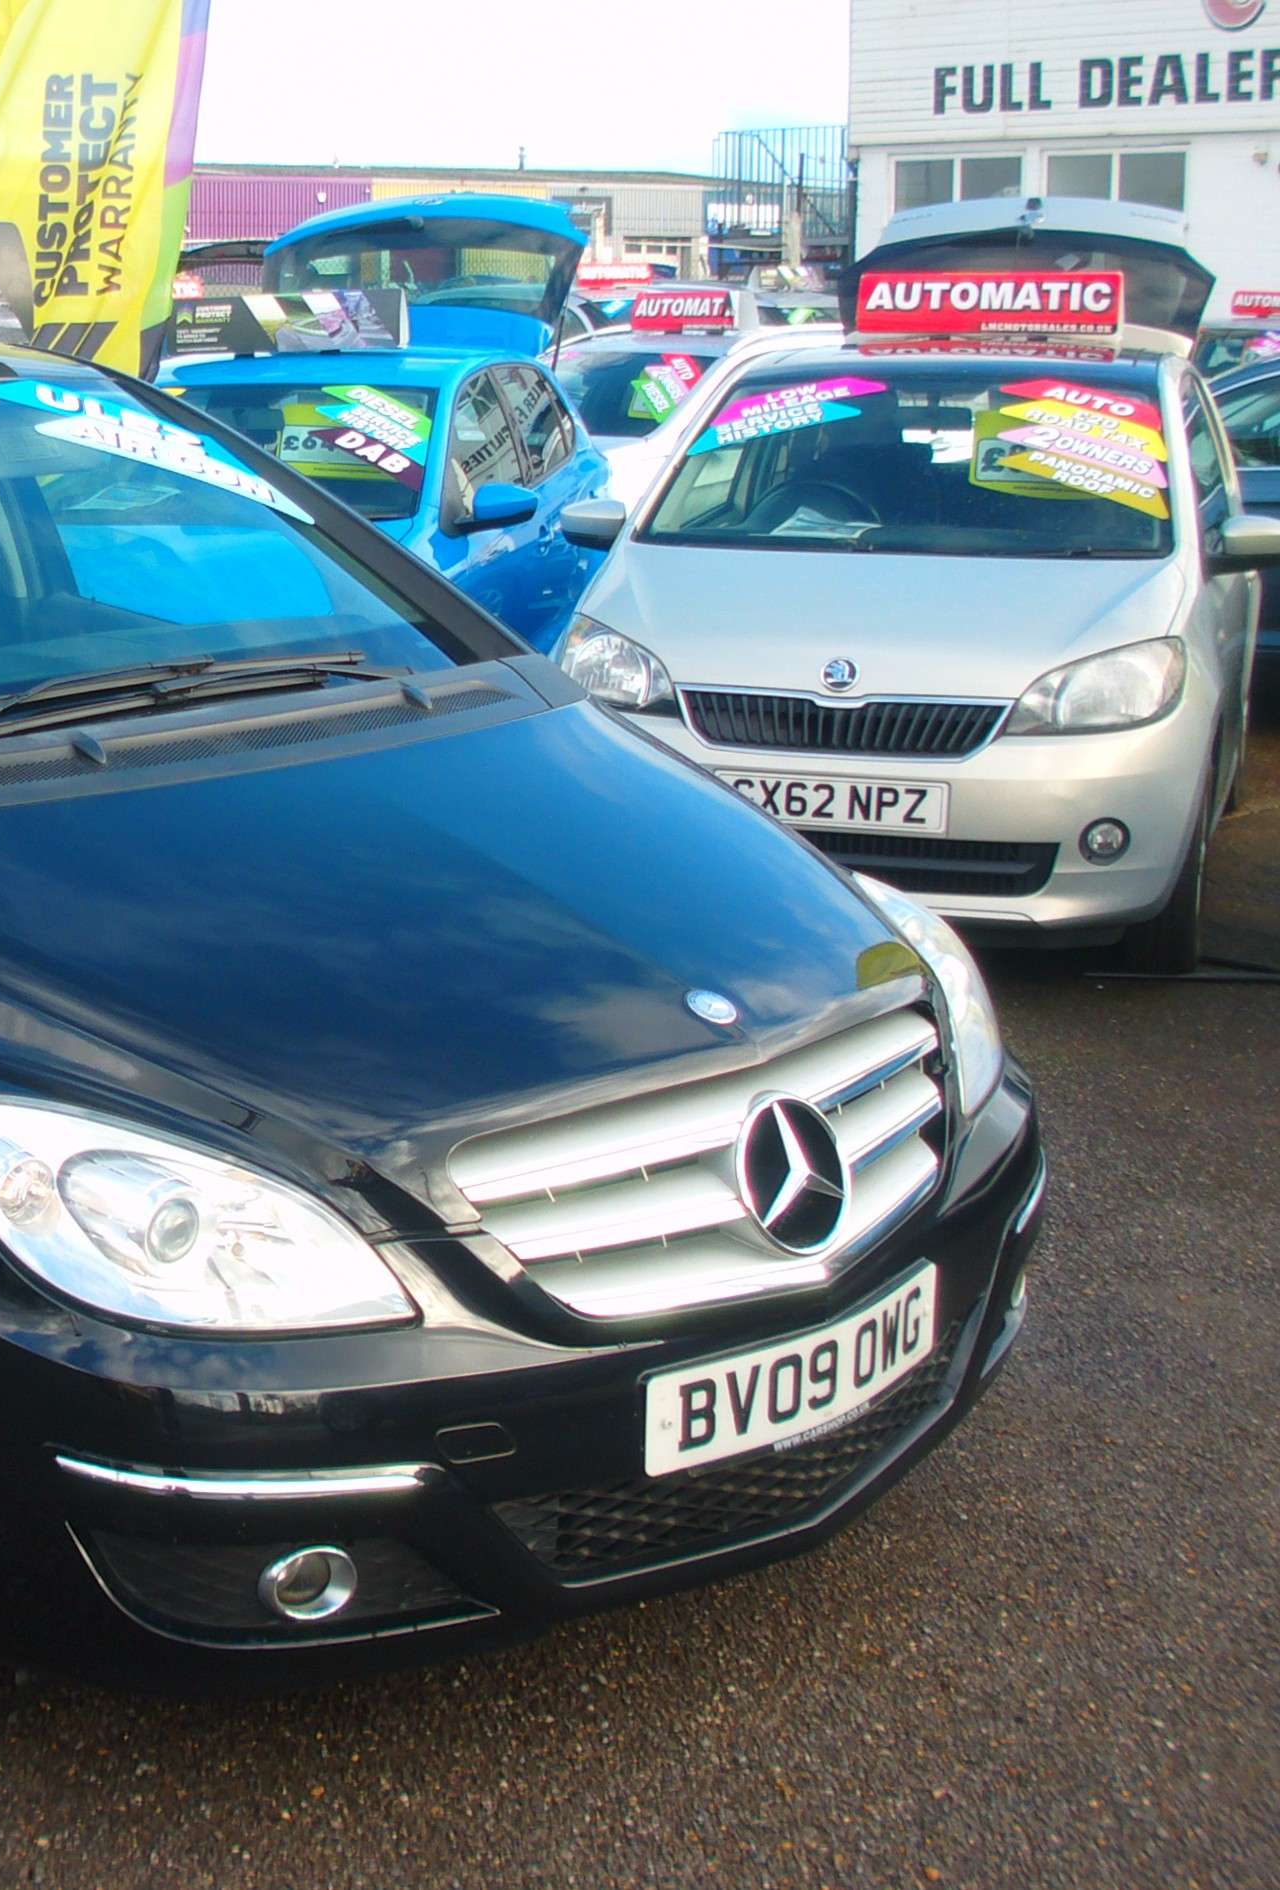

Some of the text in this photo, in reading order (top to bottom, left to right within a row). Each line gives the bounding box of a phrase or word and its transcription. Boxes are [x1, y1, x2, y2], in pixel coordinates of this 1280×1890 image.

[933, 61, 1052, 115] FULL
[33, 74, 73, 308] CUSTOMER
[54, 73, 118, 297] PROTECT
[96, 72, 143, 296] WARRANTY
[865, 281, 1113, 312] AUTOMATIC
[346, 387, 420, 431] DIESEL
[740, 386, 850, 418] MILEAGE
[765, 383, 817, 402] LOW
[1042, 386, 1136, 416] AUTO
[336, 410, 412, 451] HISTORY
[351, 405, 423, 448] SERVICE
[715, 403, 824, 435] SERVICE
[717, 413, 824, 445] HISTORY
[1024, 408, 1149, 451] ROAD TAX
[334, 430, 411, 473] DAB
[1028, 450, 1156, 499] PANORAMIC
[1052, 470, 1116, 494] ROOF
[848, 784, 928, 824] NPZ
[678, 1286, 921, 1452] BV09 OWG
